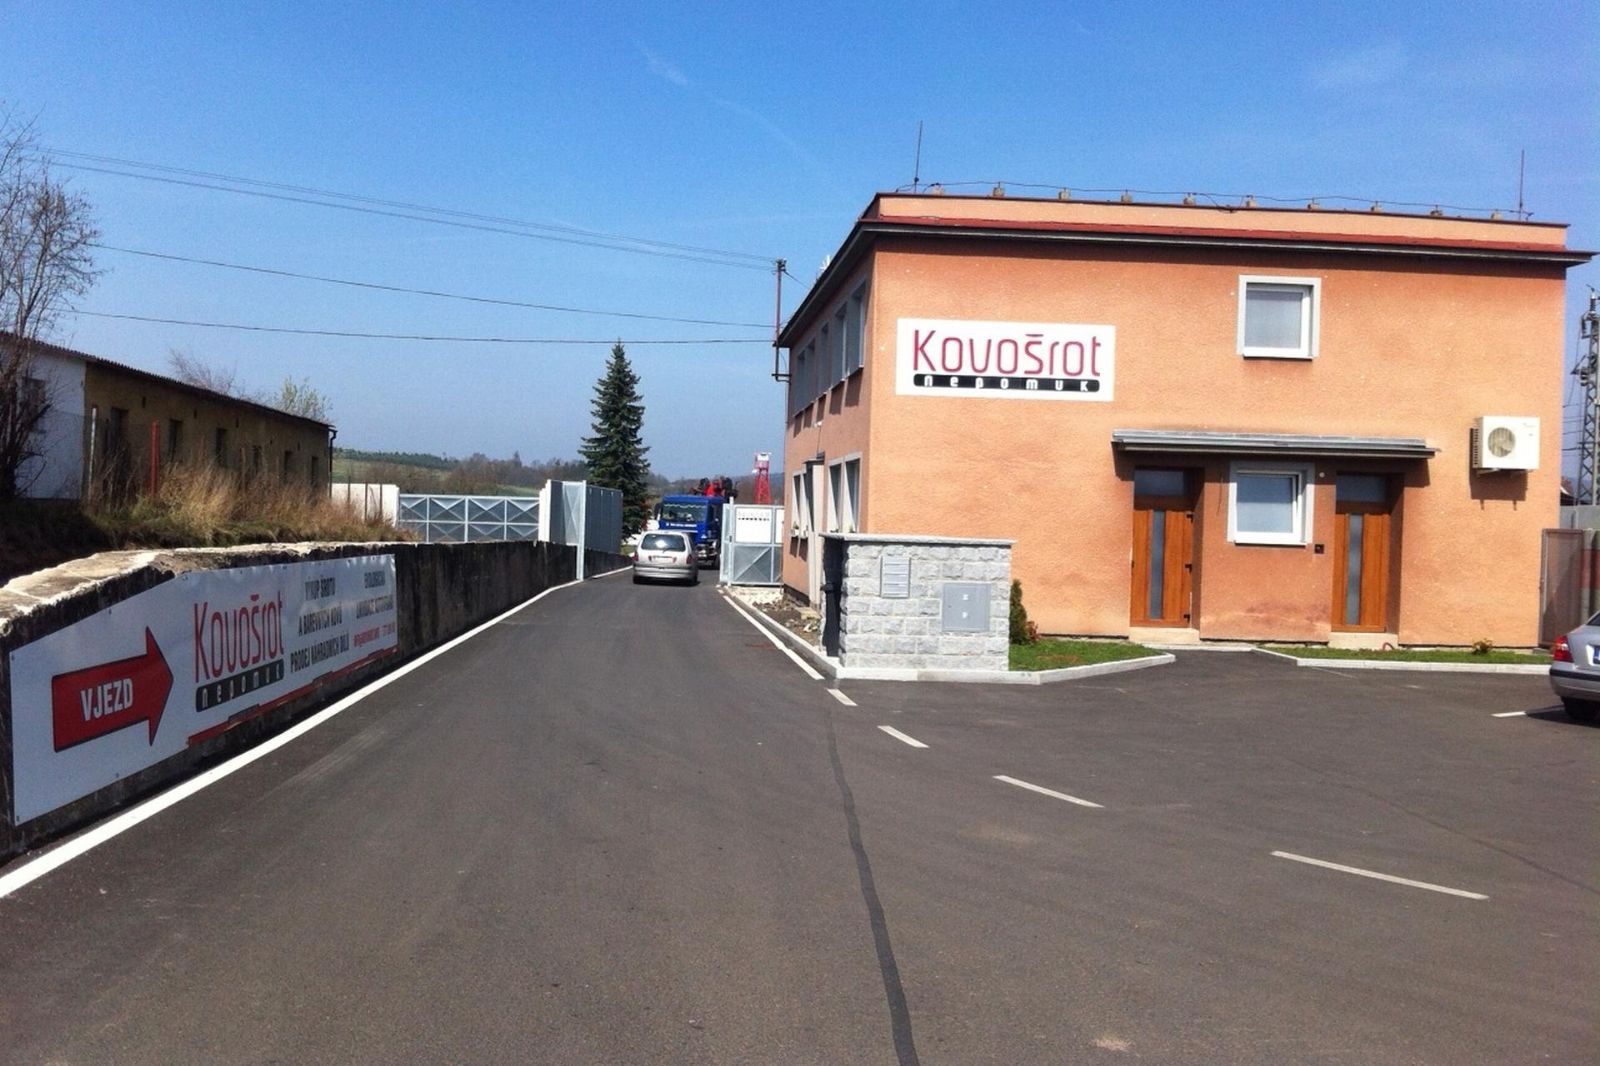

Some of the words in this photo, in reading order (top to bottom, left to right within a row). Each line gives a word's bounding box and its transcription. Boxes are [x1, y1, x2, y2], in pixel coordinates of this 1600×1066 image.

[913, 329, 1102, 377] Kovošrot
[923, 375, 1090, 392] nepomuk
[194, 590, 285, 684] Kovošrot
[81, 677, 134, 722] VJEZD
